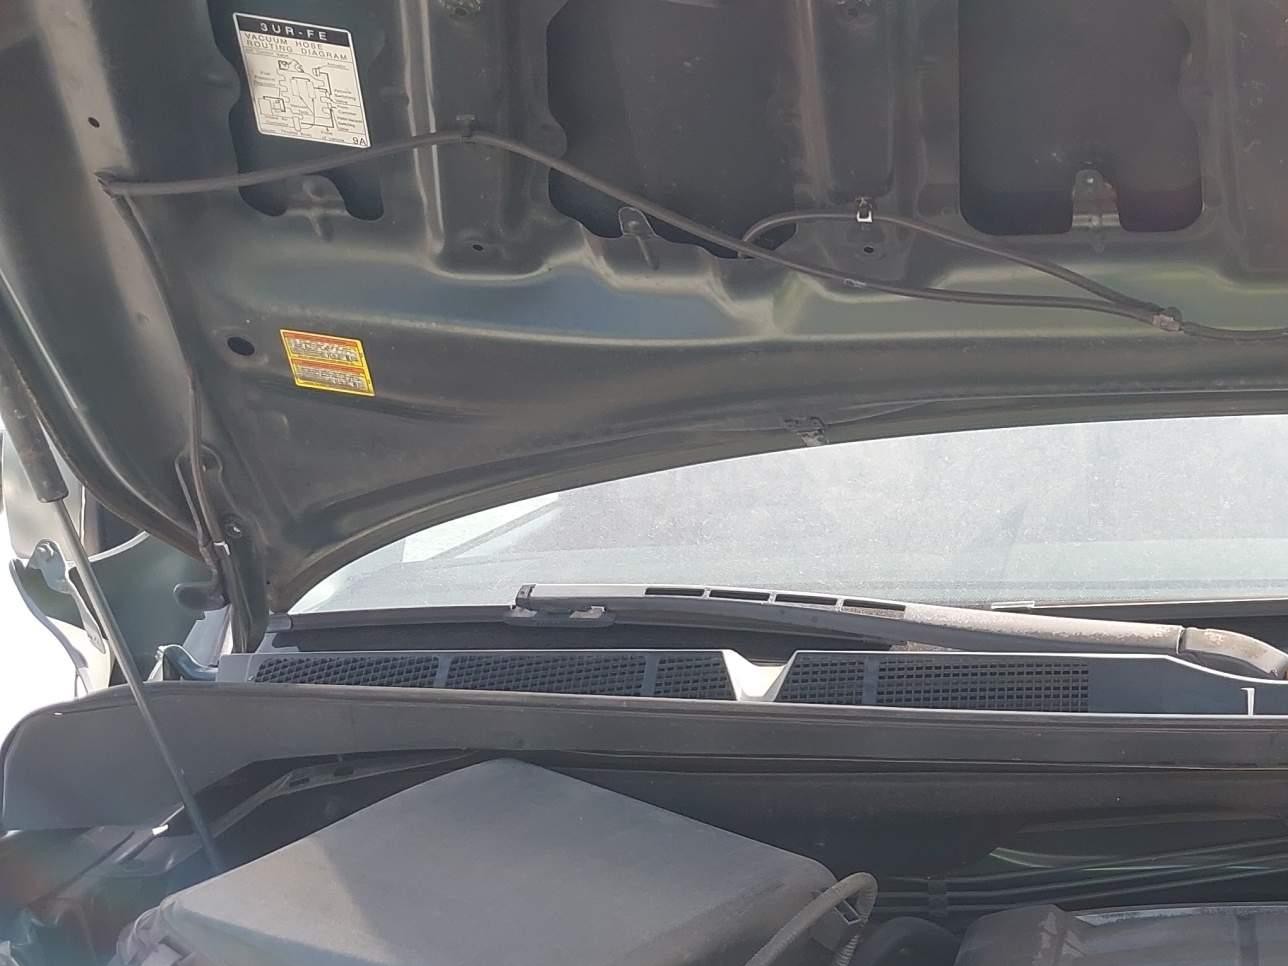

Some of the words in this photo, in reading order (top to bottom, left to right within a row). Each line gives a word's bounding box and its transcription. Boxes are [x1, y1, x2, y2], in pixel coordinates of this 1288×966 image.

[260, 22, 328, 41] 3UR-FE
[244, 33, 288, 45] VACUUM
[295, 41, 322, 51] HOSE
[246, 40, 293, 53] ROUTING
[301, 48, 348, 60] DIAGRAM
